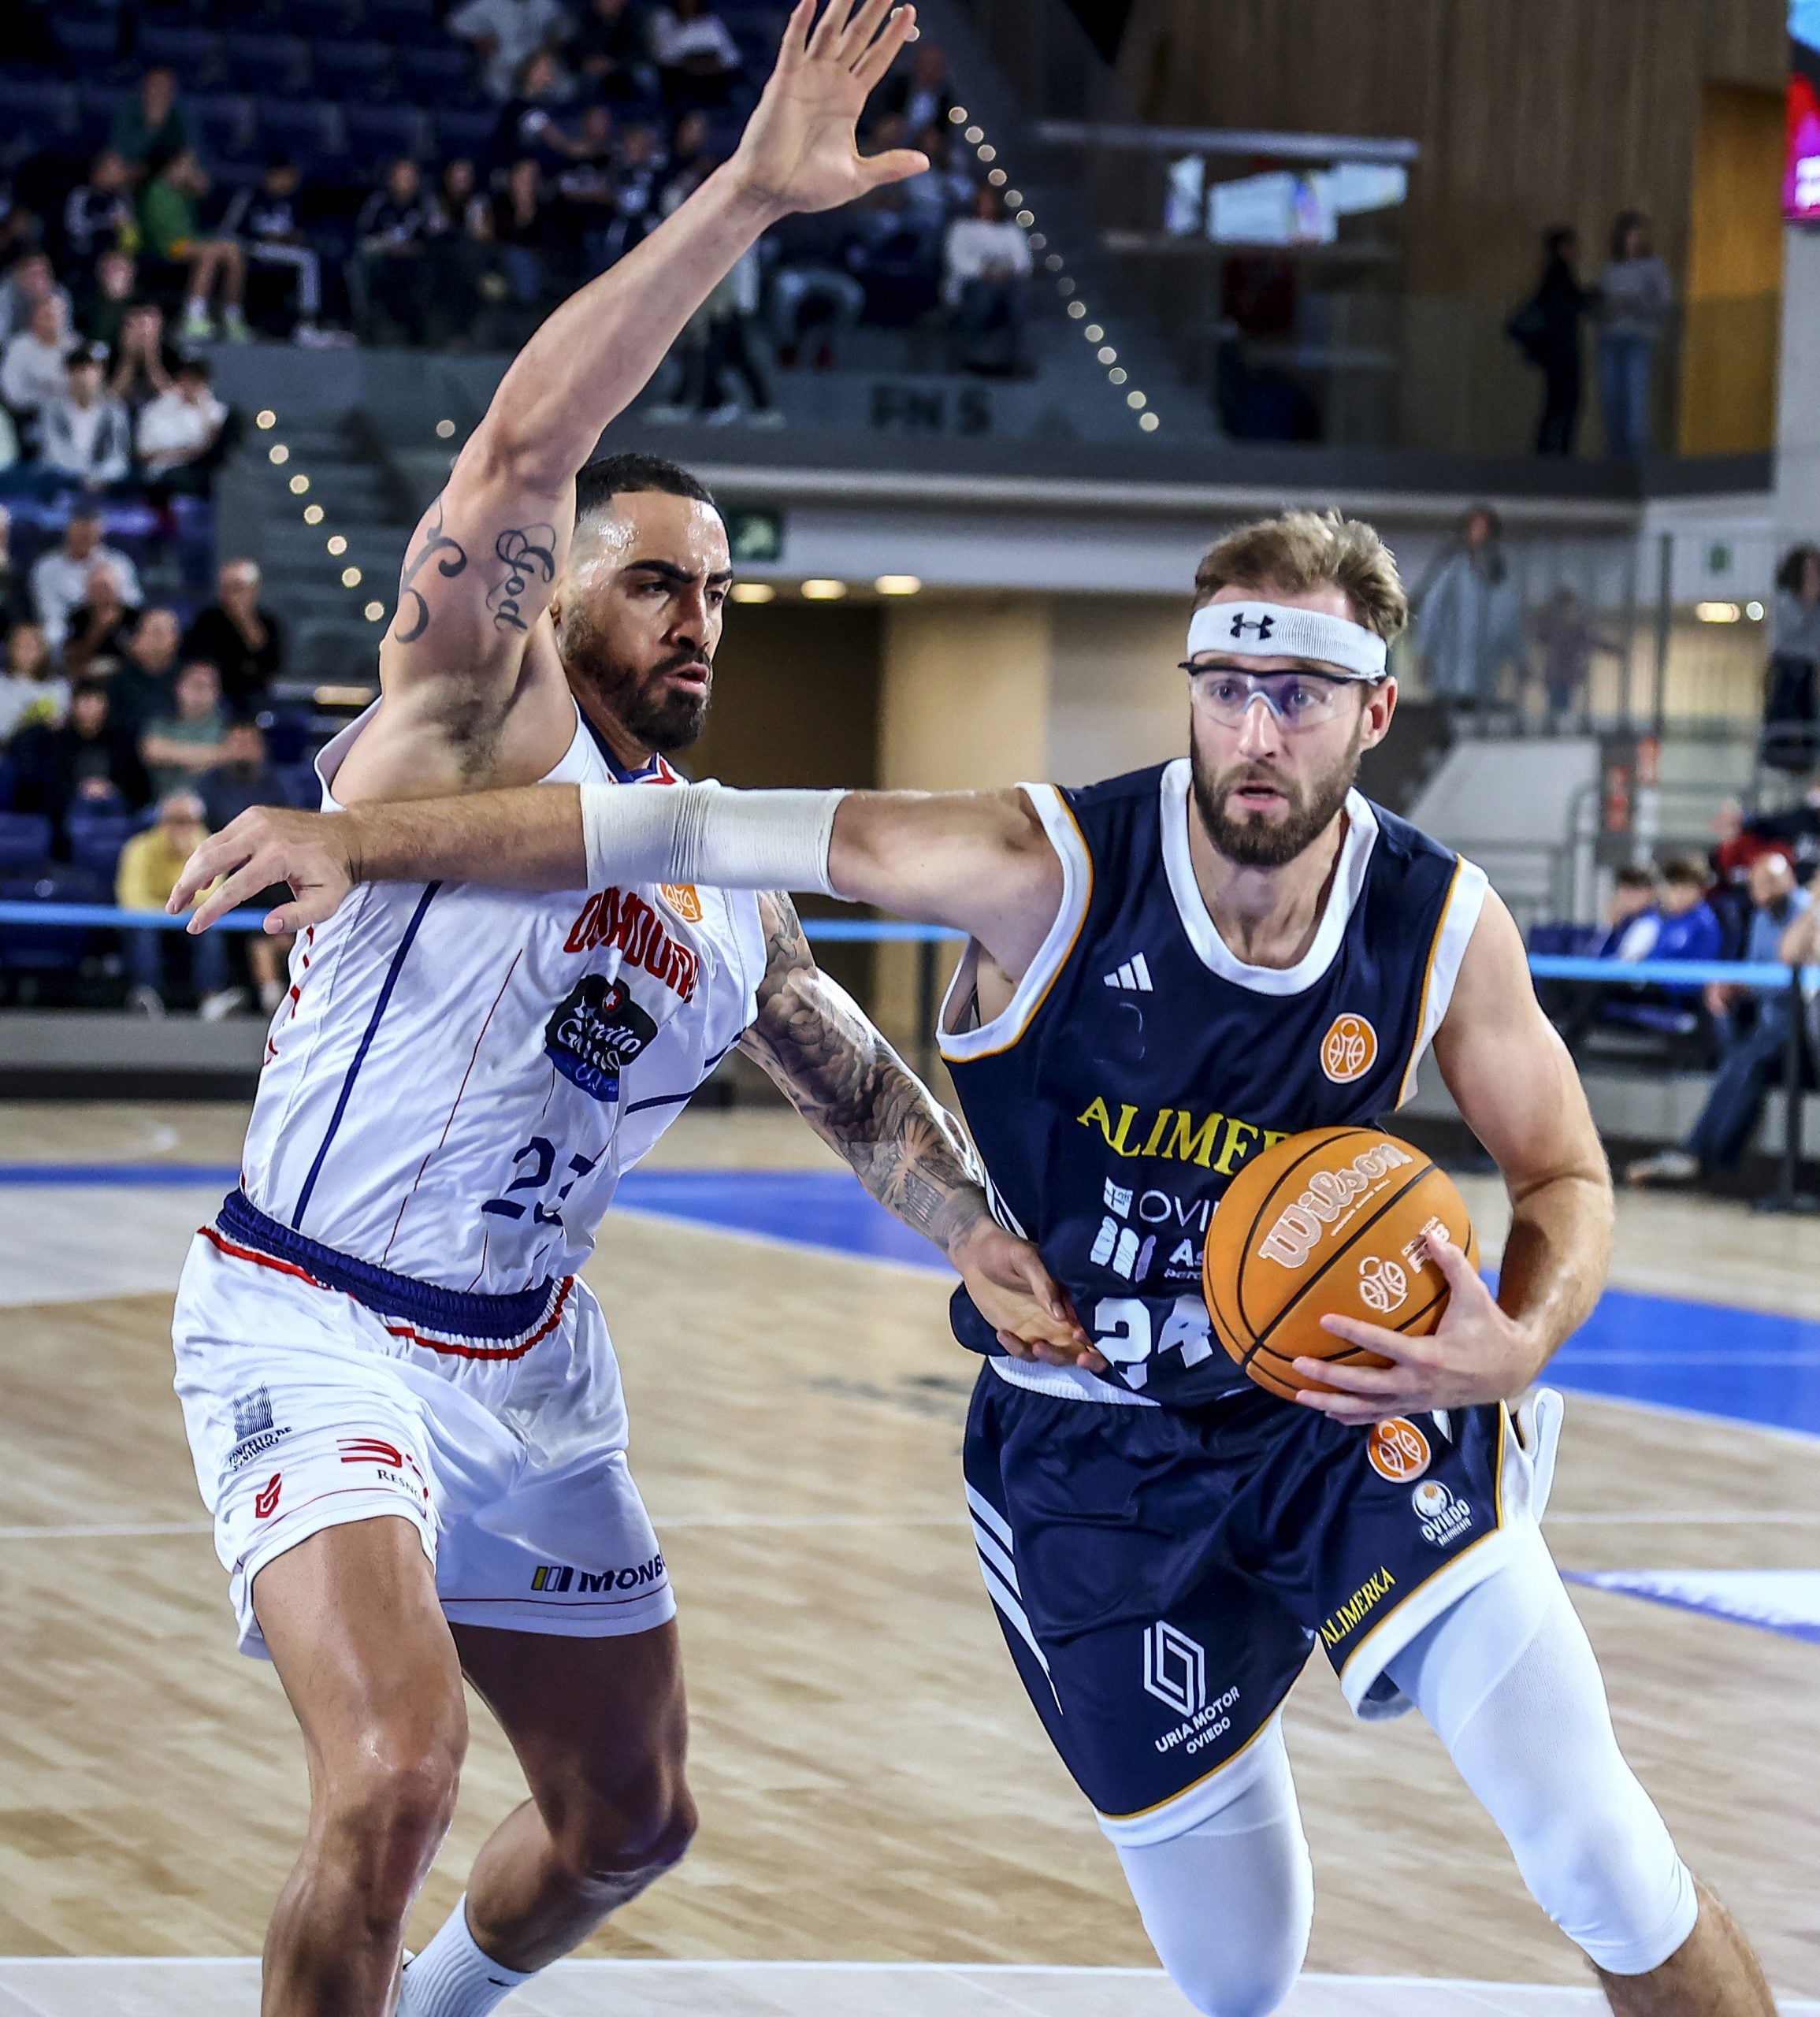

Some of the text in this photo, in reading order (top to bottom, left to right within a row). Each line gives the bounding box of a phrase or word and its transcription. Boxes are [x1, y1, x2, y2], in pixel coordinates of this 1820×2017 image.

[1139, 1190, 1220, 1232] OVI
[1258, 1143, 1413, 1269] Wilson
[1421, 1499, 1472, 1543] OVIEDO
[578, 1554, 666, 1592] MONB
[1320, 1566, 1397, 1650] ALIMERKA
[1154, 1685, 1241, 1753] URIA MOTOR
[1186, 1716, 1231, 1755] OVIEDO
